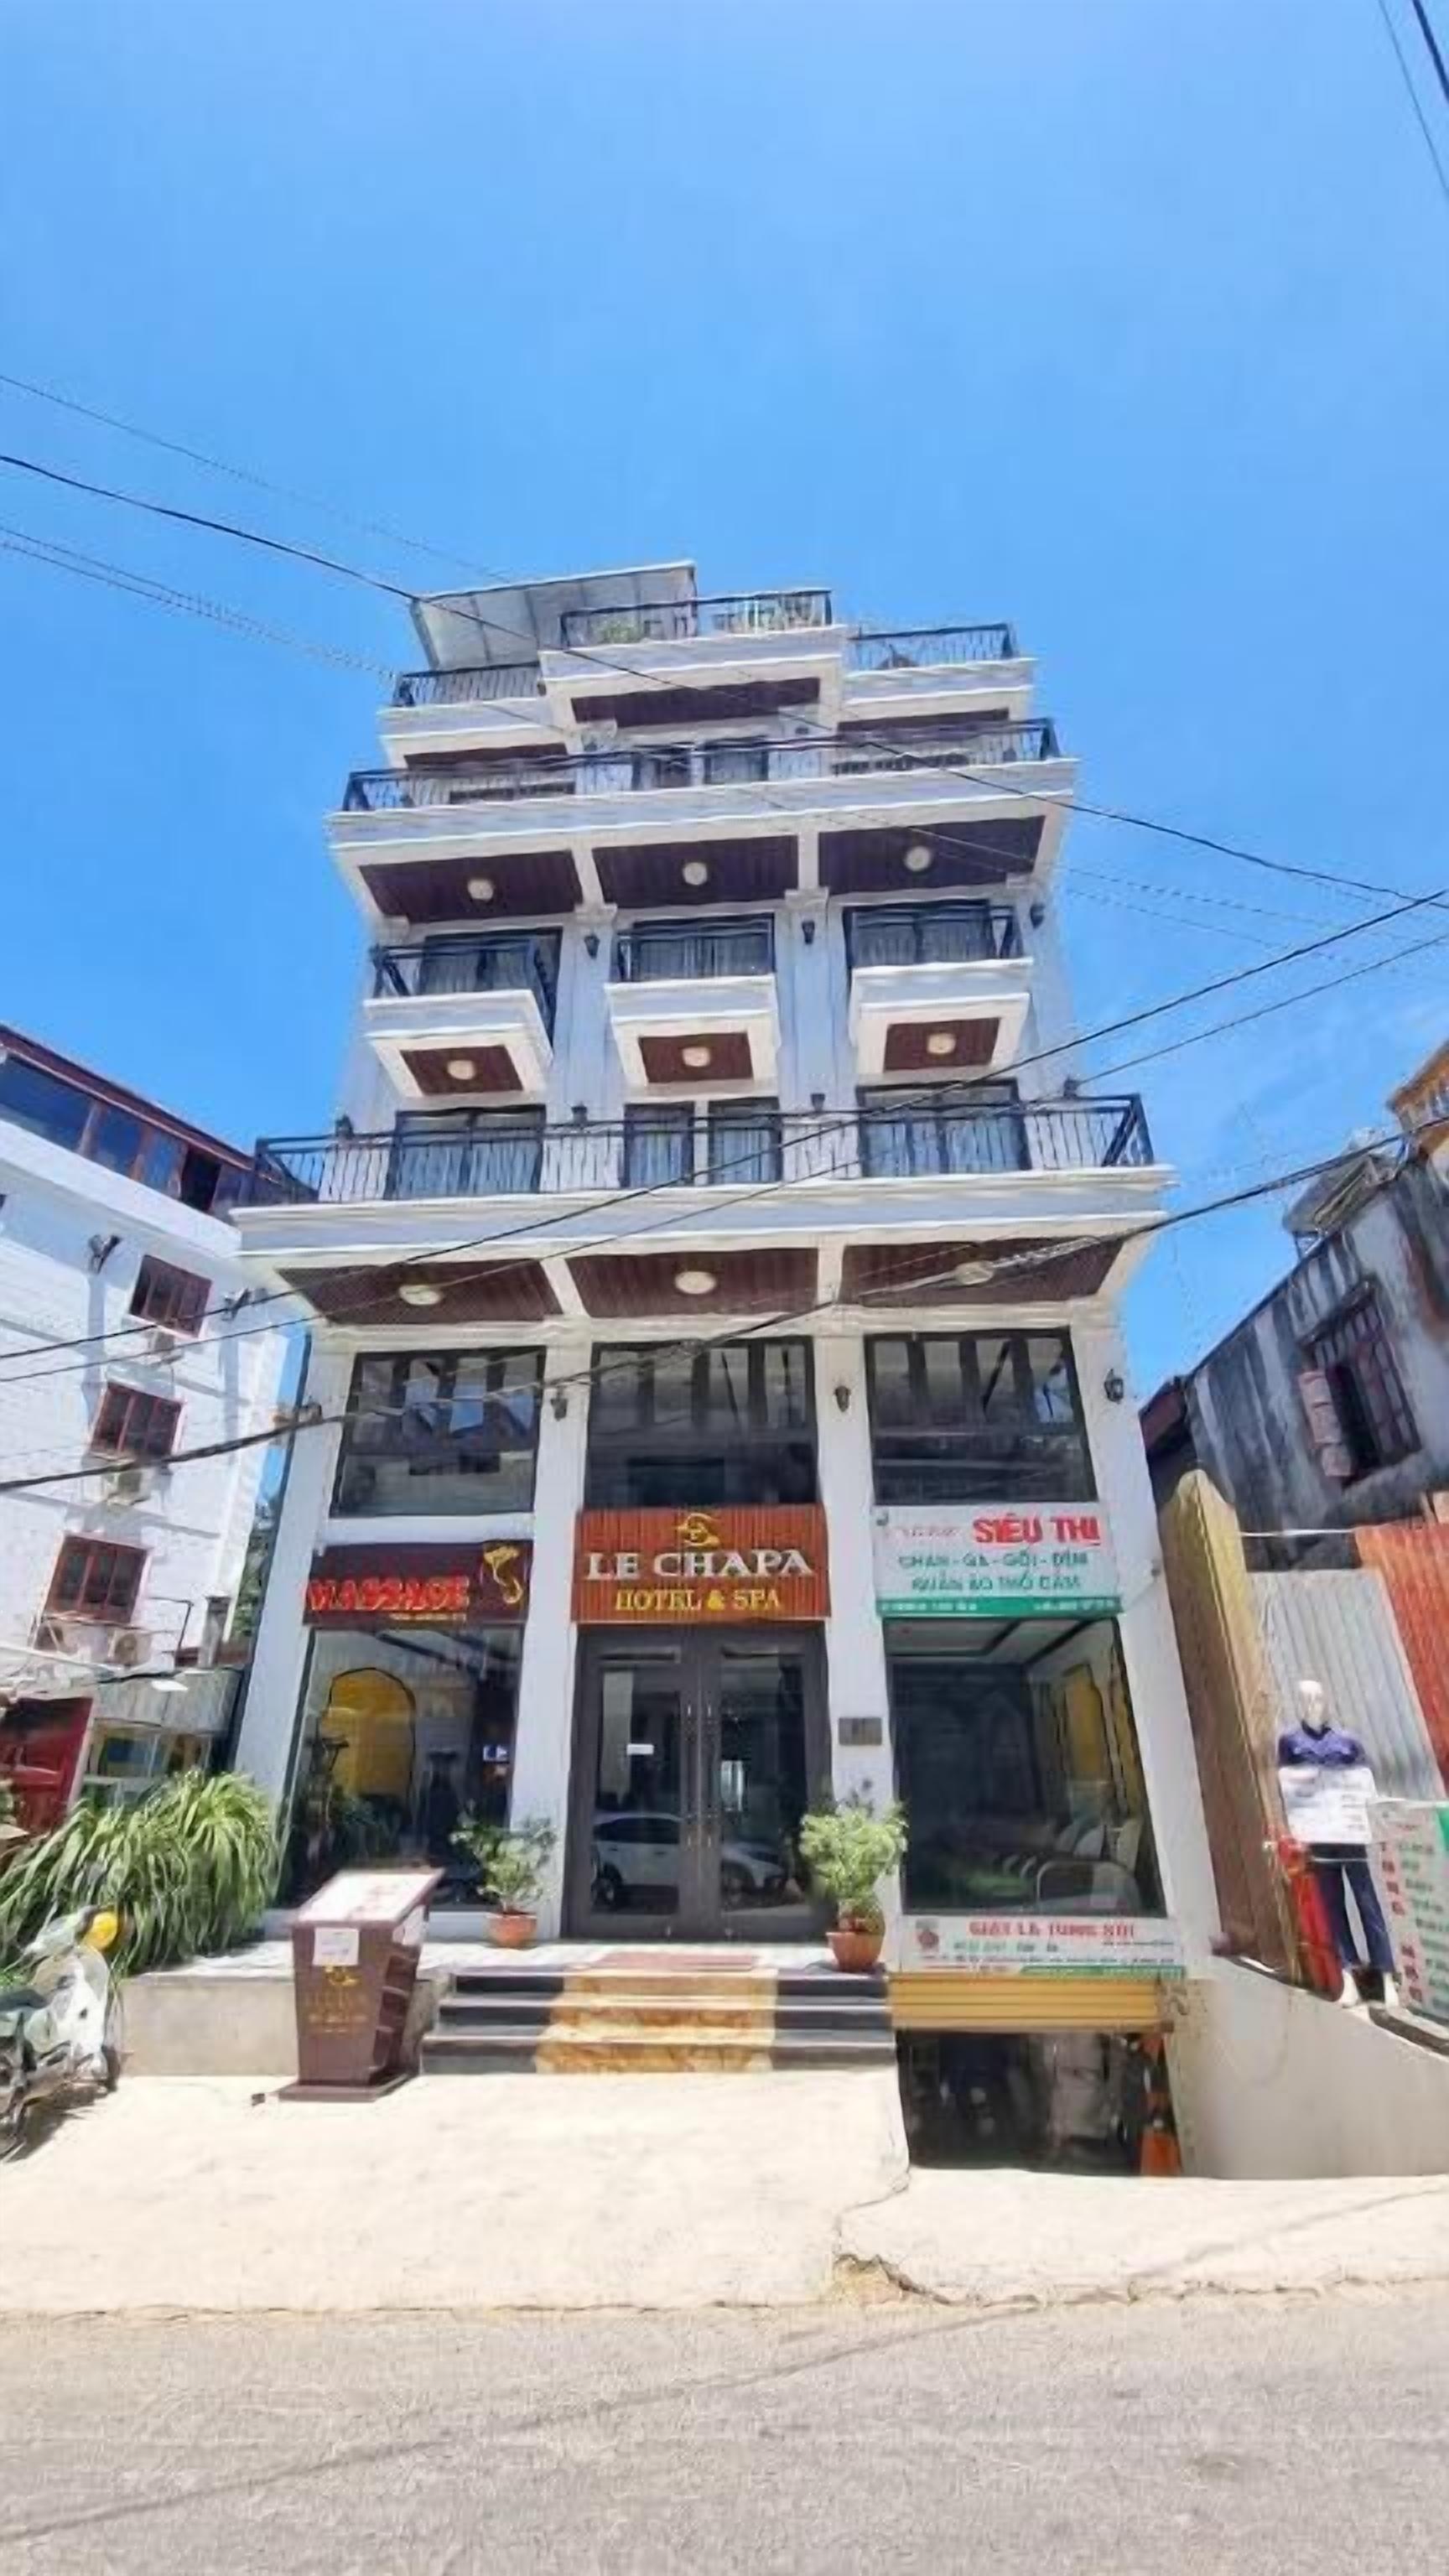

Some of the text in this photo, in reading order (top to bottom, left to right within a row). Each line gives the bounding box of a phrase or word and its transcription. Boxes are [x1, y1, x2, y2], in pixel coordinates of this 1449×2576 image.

[972, 1512, 1043, 1544] SIÊU
[587, 1549, 813, 1581] LE CHAPA
[615, 1588, 782, 1612] HOTEL & SPA
